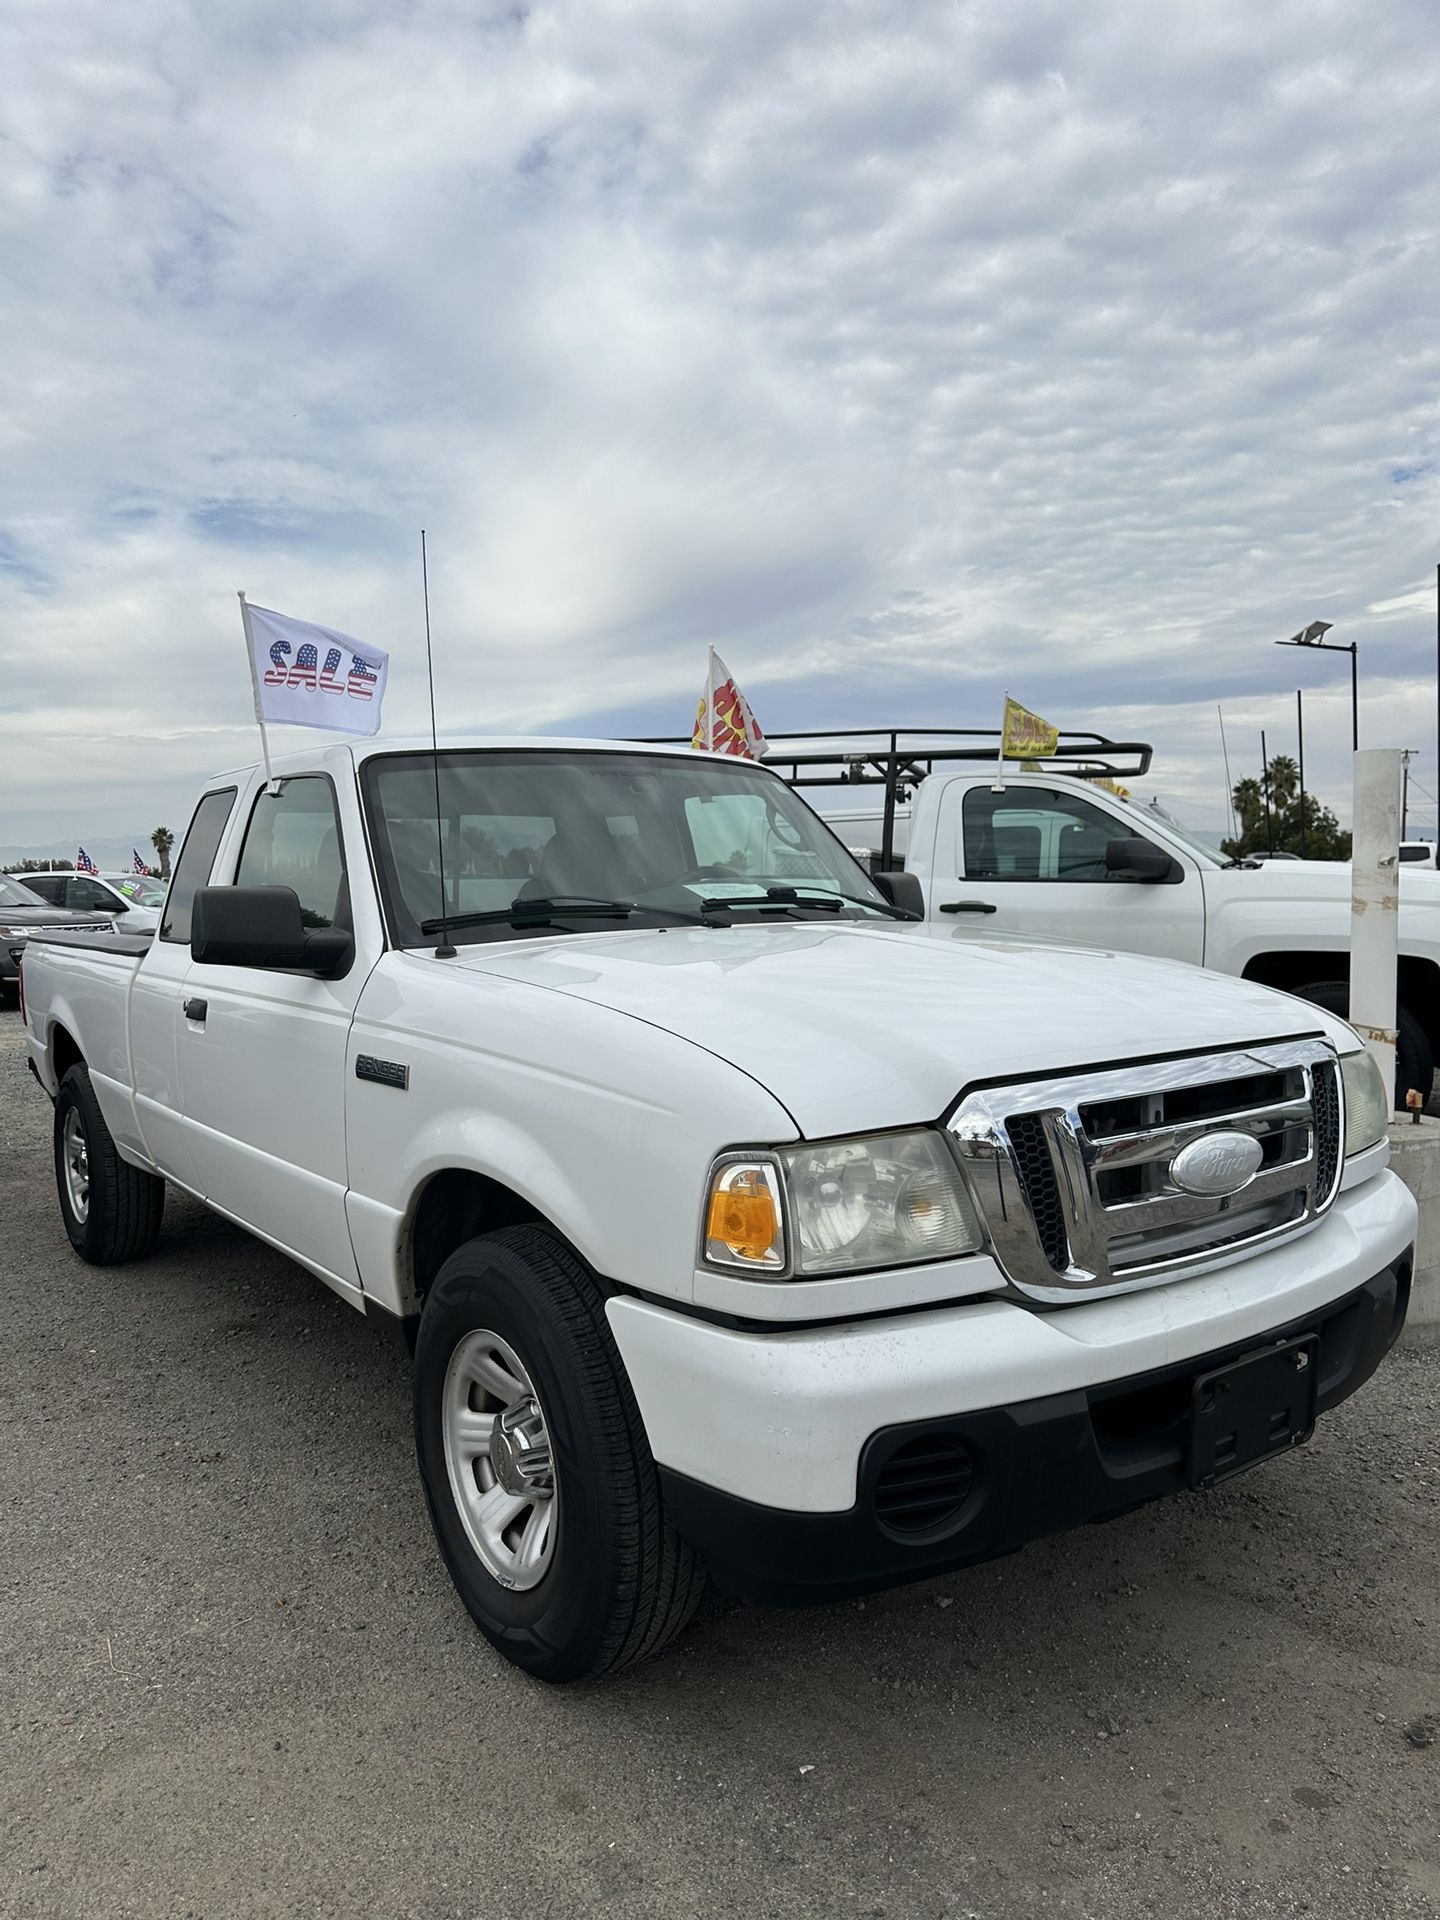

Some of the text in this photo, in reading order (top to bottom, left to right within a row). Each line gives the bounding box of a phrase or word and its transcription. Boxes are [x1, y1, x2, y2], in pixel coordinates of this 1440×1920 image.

[264, 640, 378, 702] SALE
[357, 1055, 406, 1080] RANGER
[1192, 1140, 1249, 1177] Ford
